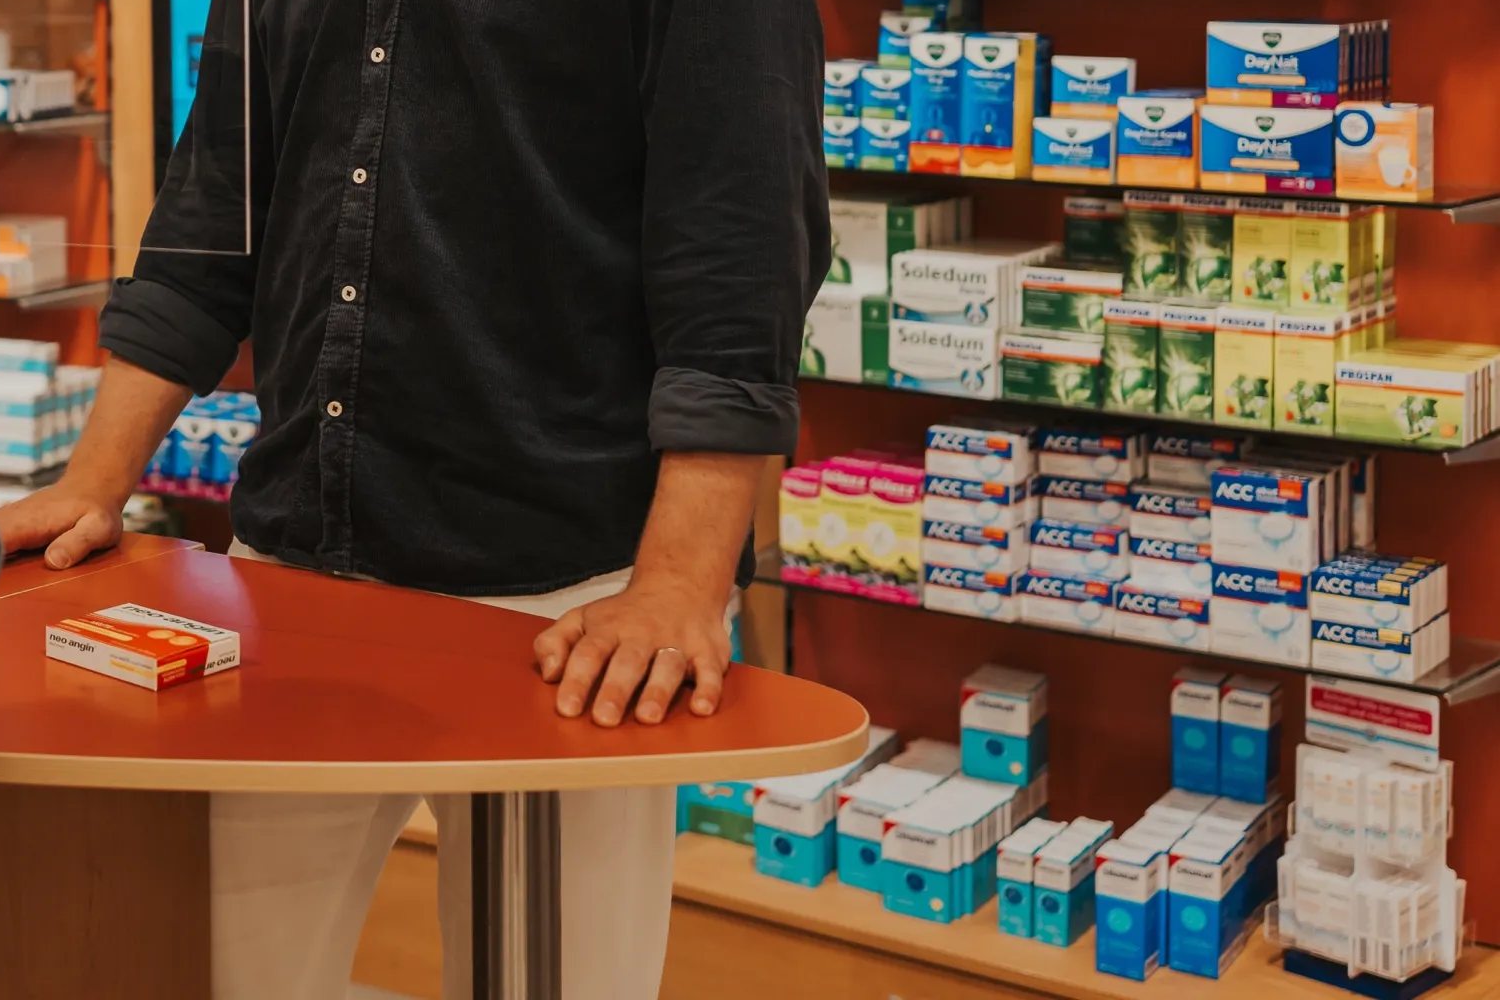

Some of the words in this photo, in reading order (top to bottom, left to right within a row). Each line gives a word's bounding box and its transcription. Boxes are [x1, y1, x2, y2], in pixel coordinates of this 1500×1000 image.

[900, 261, 989, 286] Soledum
[897, 325, 985, 351] Soledum
[1340, 369, 1394, 384] PROSPAN
[930, 431, 966, 452] ACC
[1045, 434, 1080, 454] ACC
[1153, 436, 1189, 452] ACC
[927, 478, 963, 498] ACC
[1216, 481, 1254, 502] ACC
[1136, 494, 1173, 514] ACC
[927, 520, 963, 541] ACC
[1035, 527, 1072, 549] ACC
[1136, 538, 1174, 559] ACC
[929, 567, 965, 588] ACC
[1026, 575, 1063, 597] ACC
[1214, 571, 1254, 593] ACC
[1315, 575, 1353, 596] ACC
[1118, 593, 1156, 615] ACC
[49, 632, 68, 645] neo
[68, 638, 96, 654] angin
[1317, 623, 1355, 644] ACC
